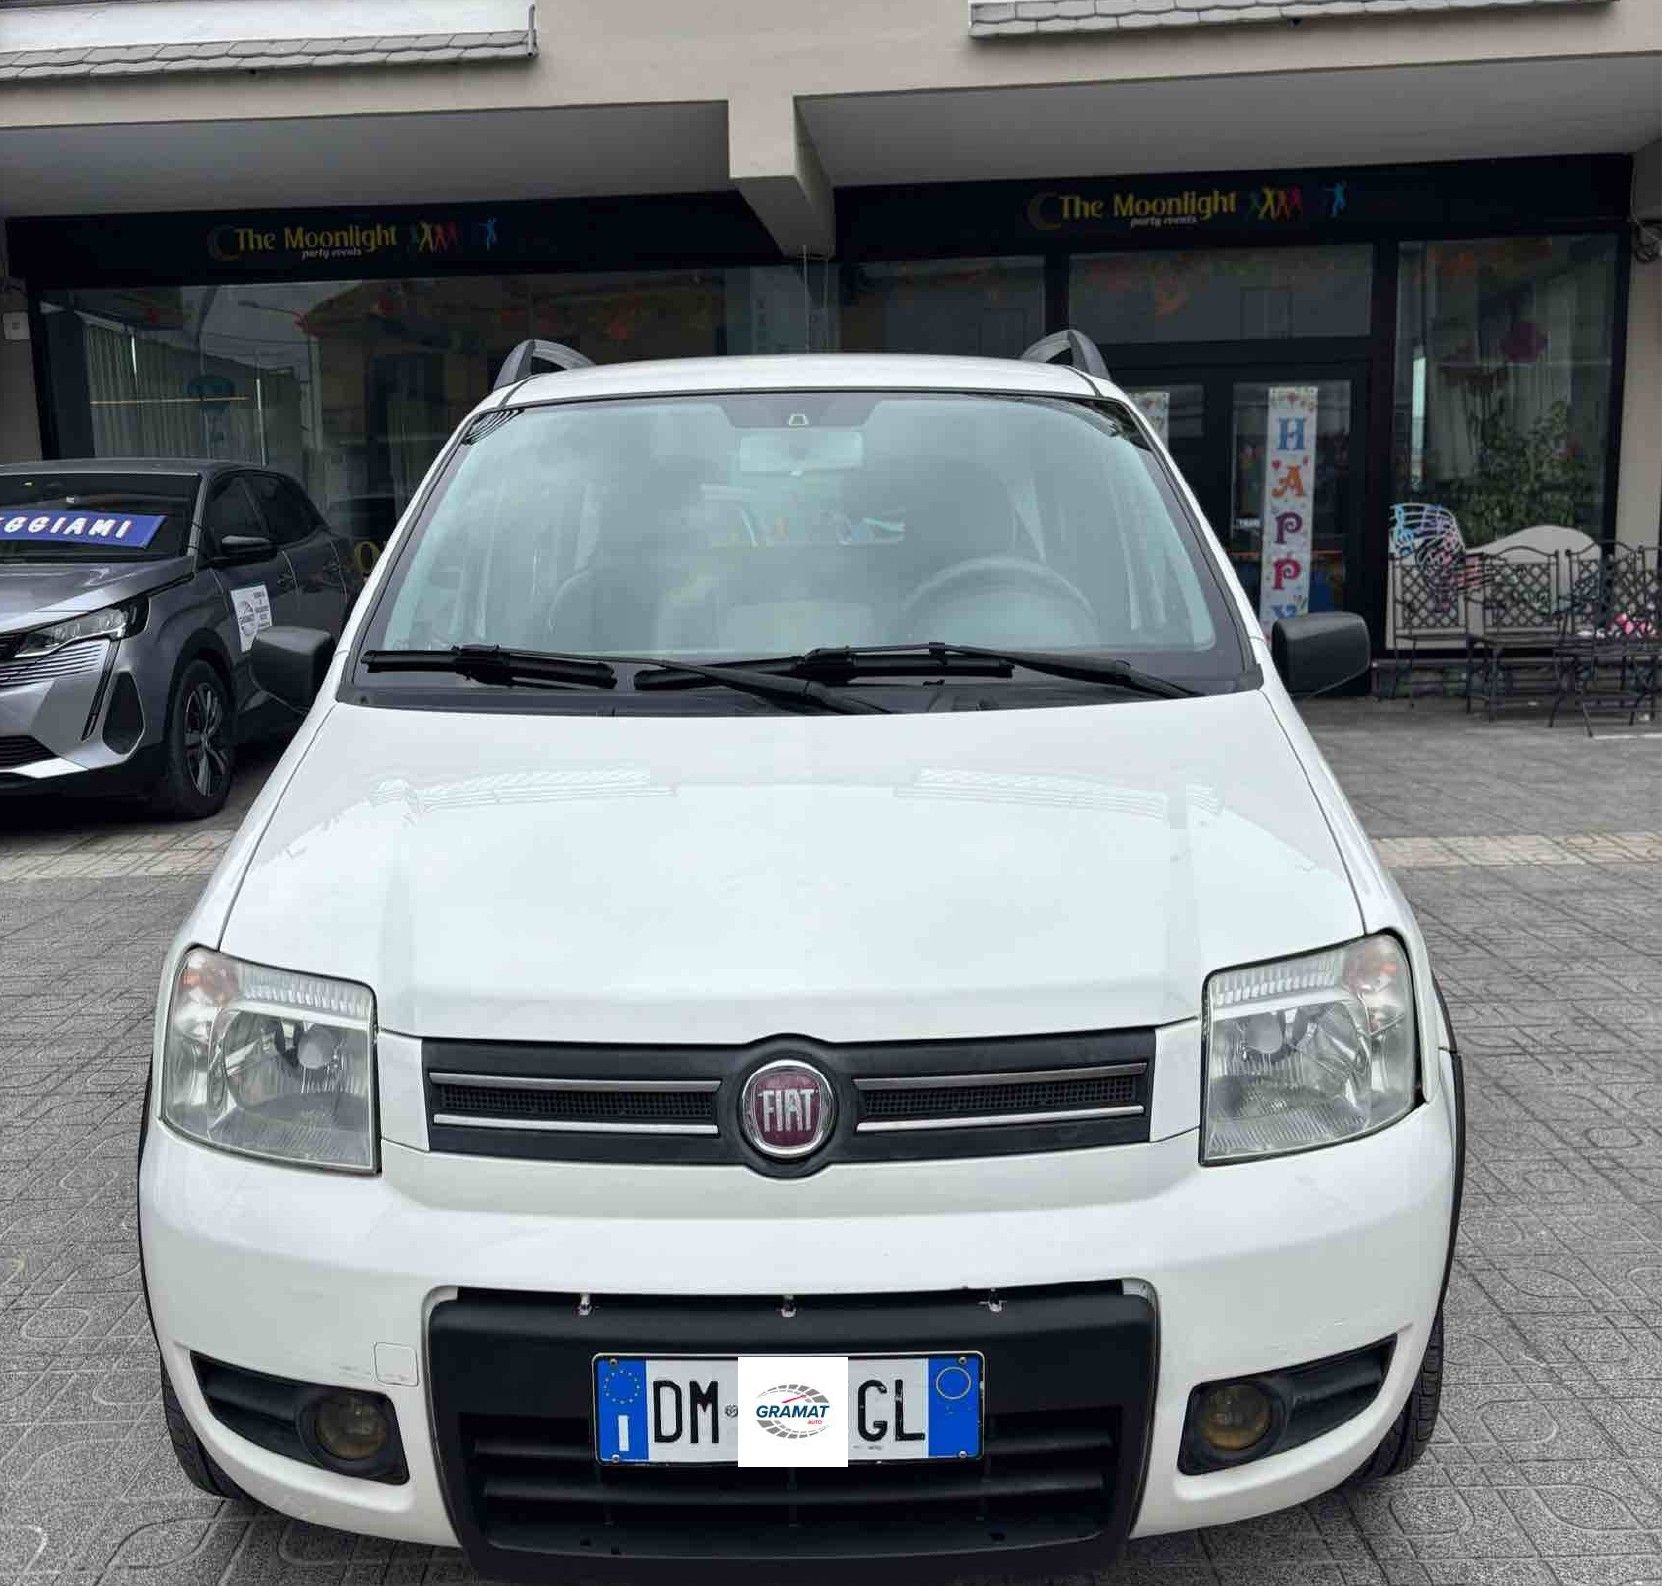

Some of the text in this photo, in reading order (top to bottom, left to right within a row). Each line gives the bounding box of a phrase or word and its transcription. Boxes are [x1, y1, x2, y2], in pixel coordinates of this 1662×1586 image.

[1060, 190, 1236, 220] The Moonlight
[1131, 216, 1161, 228] party
[234, 224, 397, 251] The Moonlight
[302, 248, 329, 259] party
[0, 516, 132, 539] GGIAMI
[758, 1088, 816, 1132] FIAT
[653, 1379, 926, 1443] DM GL
[618, 1415, 629, 1451] I
